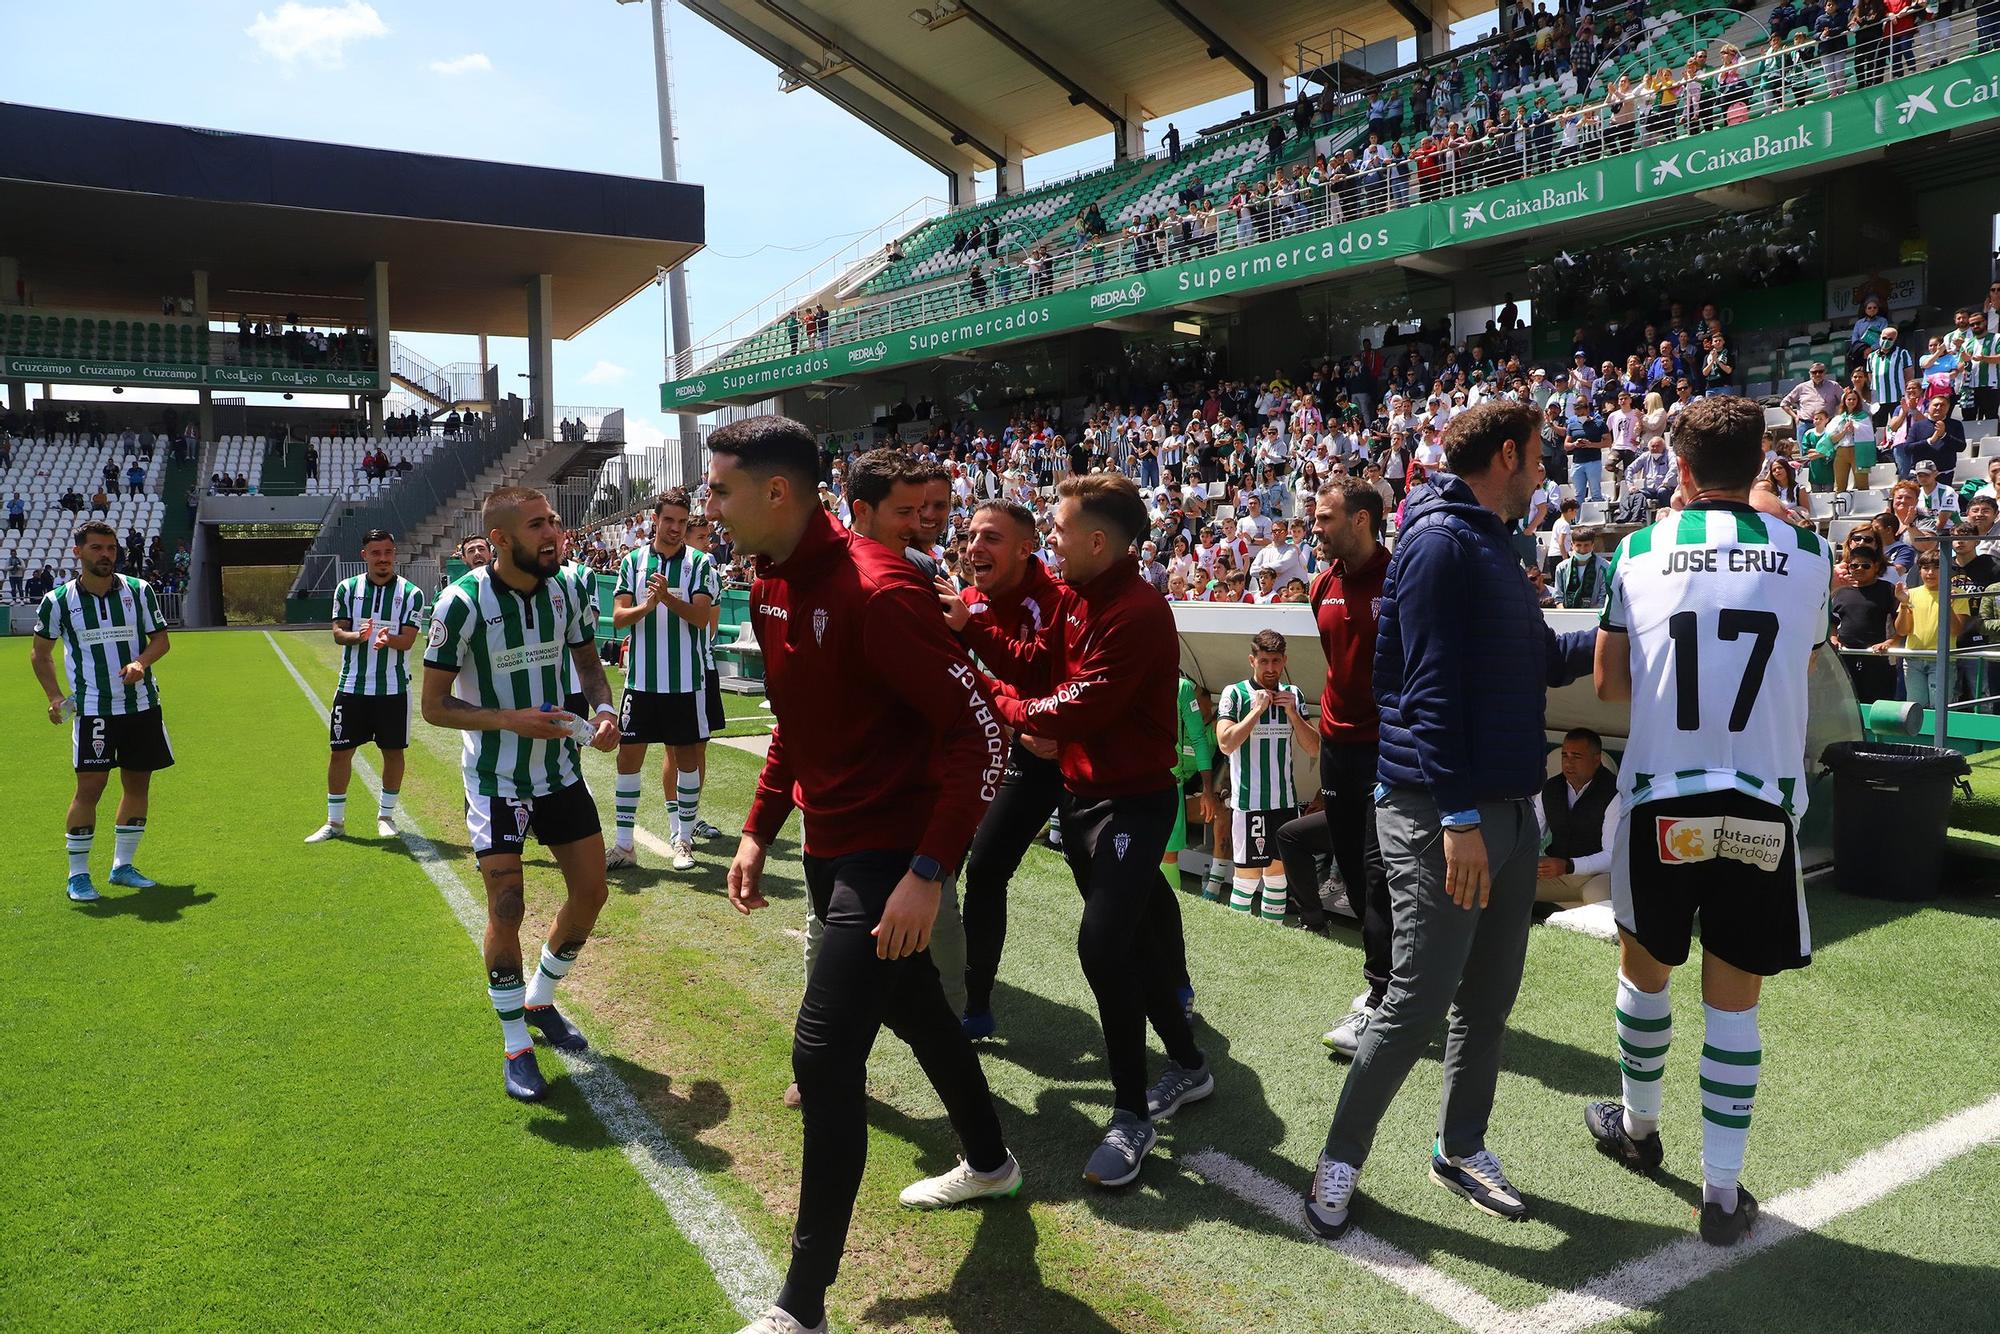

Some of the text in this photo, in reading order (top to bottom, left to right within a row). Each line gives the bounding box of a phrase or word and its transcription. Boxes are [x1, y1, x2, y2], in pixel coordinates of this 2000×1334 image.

[1686, 126, 1814, 175] CaixaBank
[1489, 180, 1590, 221] CaixaBank
[1178, 228, 1390, 291] Supermercados
[909, 307, 1050, 351] Supermercados
[12, 361, 197, 379] Cruzcampo Cruzcampo Cruzcampo
[723, 357, 829, 389] Supermercados
[1662, 549, 1789, 577] JOSE CRUZ
[948, 663, 976, 690] CF
[1669, 608, 1779, 732] 17
[334, 705, 343, 723] 5
[622, 694, 631, 714] 6
[92, 718, 105, 739] 2
[1251, 815, 1266, 837] 21
[1720, 840, 1779, 864] Córdoba
